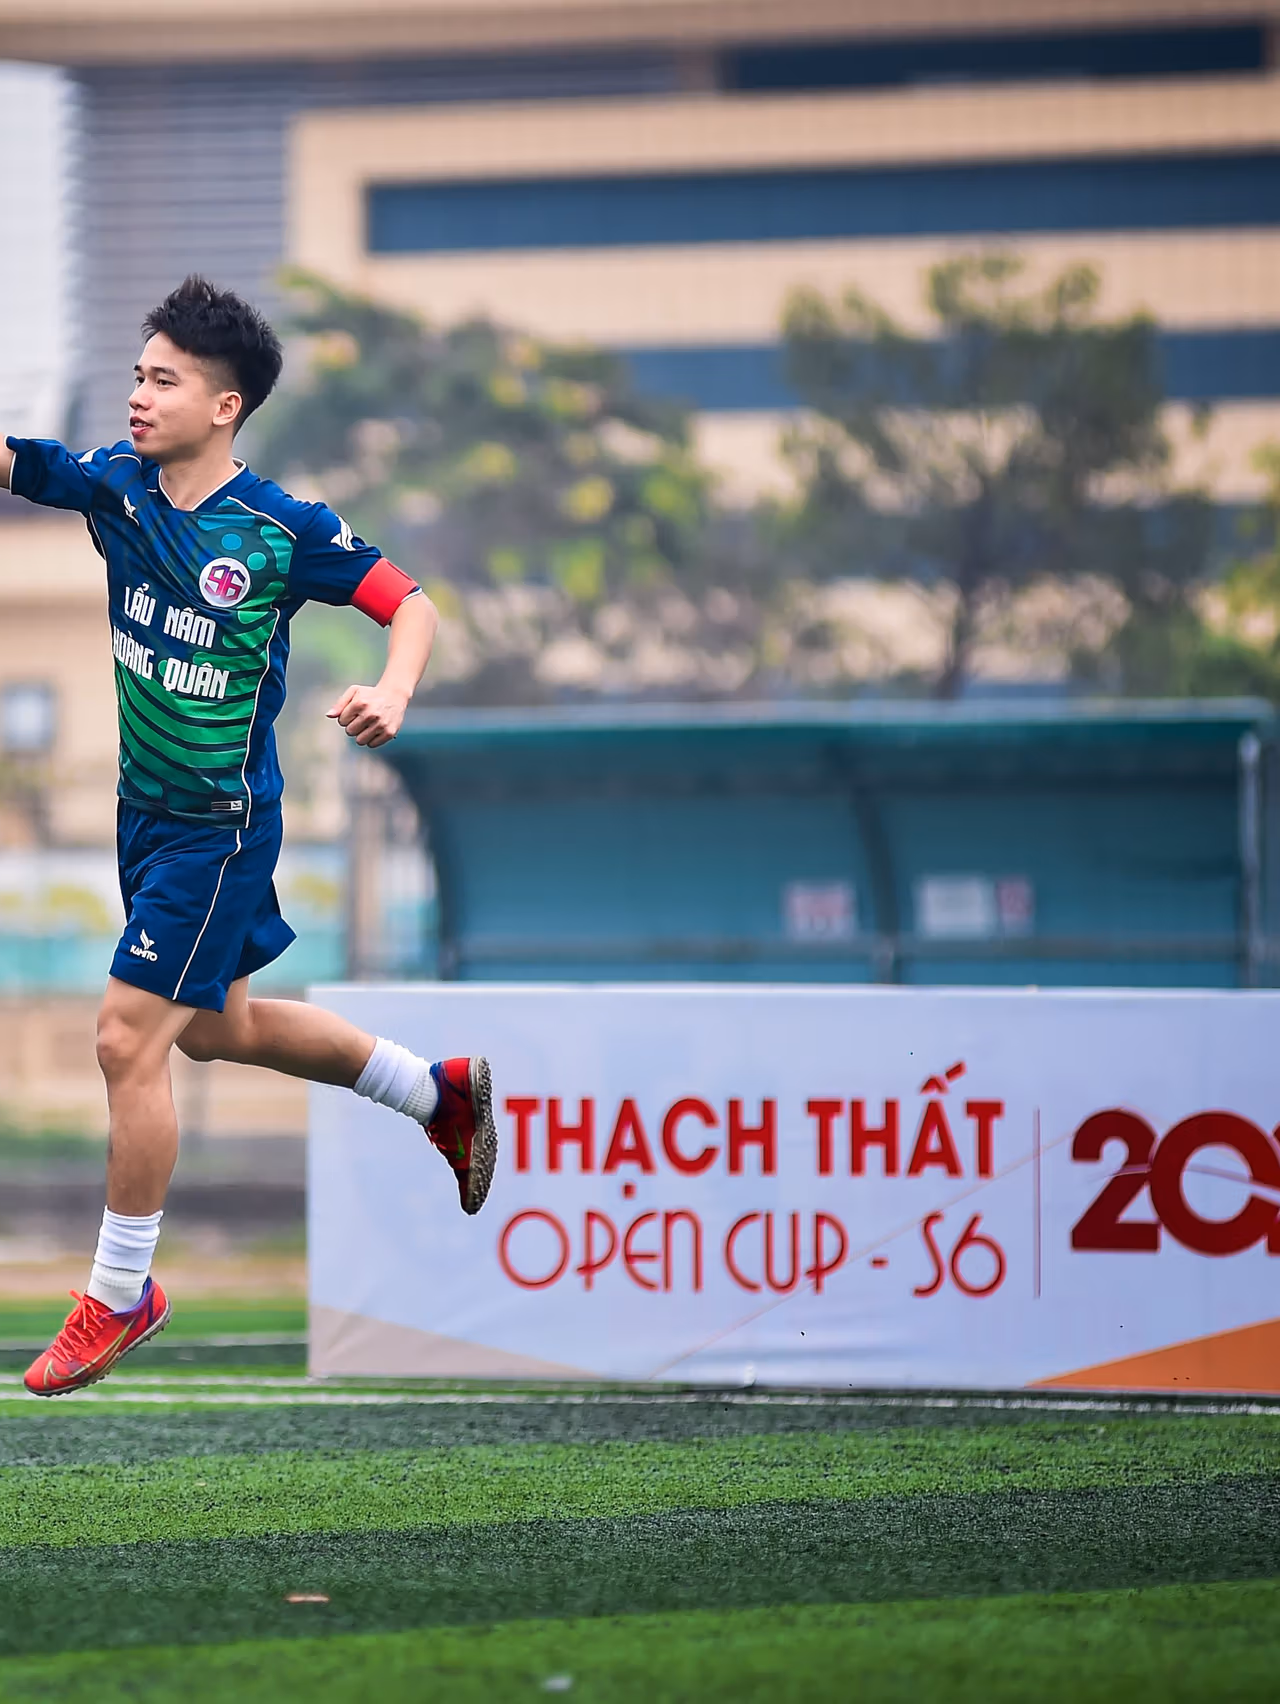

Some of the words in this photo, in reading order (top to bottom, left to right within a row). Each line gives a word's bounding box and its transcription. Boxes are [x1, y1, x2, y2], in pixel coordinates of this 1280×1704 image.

[124, 582, 157, 627] LẨU
[162, 657, 230, 699] QUÂN
[504, 1096, 777, 1199] THẠCH
[805, 1060, 1004, 1180] THẤT
[1070, 1107, 1280, 1258] 20
[497, 1208, 703, 1292] OPEN
[723, 1209, 849, 1295] CUP
[912, 1211, 1007, 1298] S6
